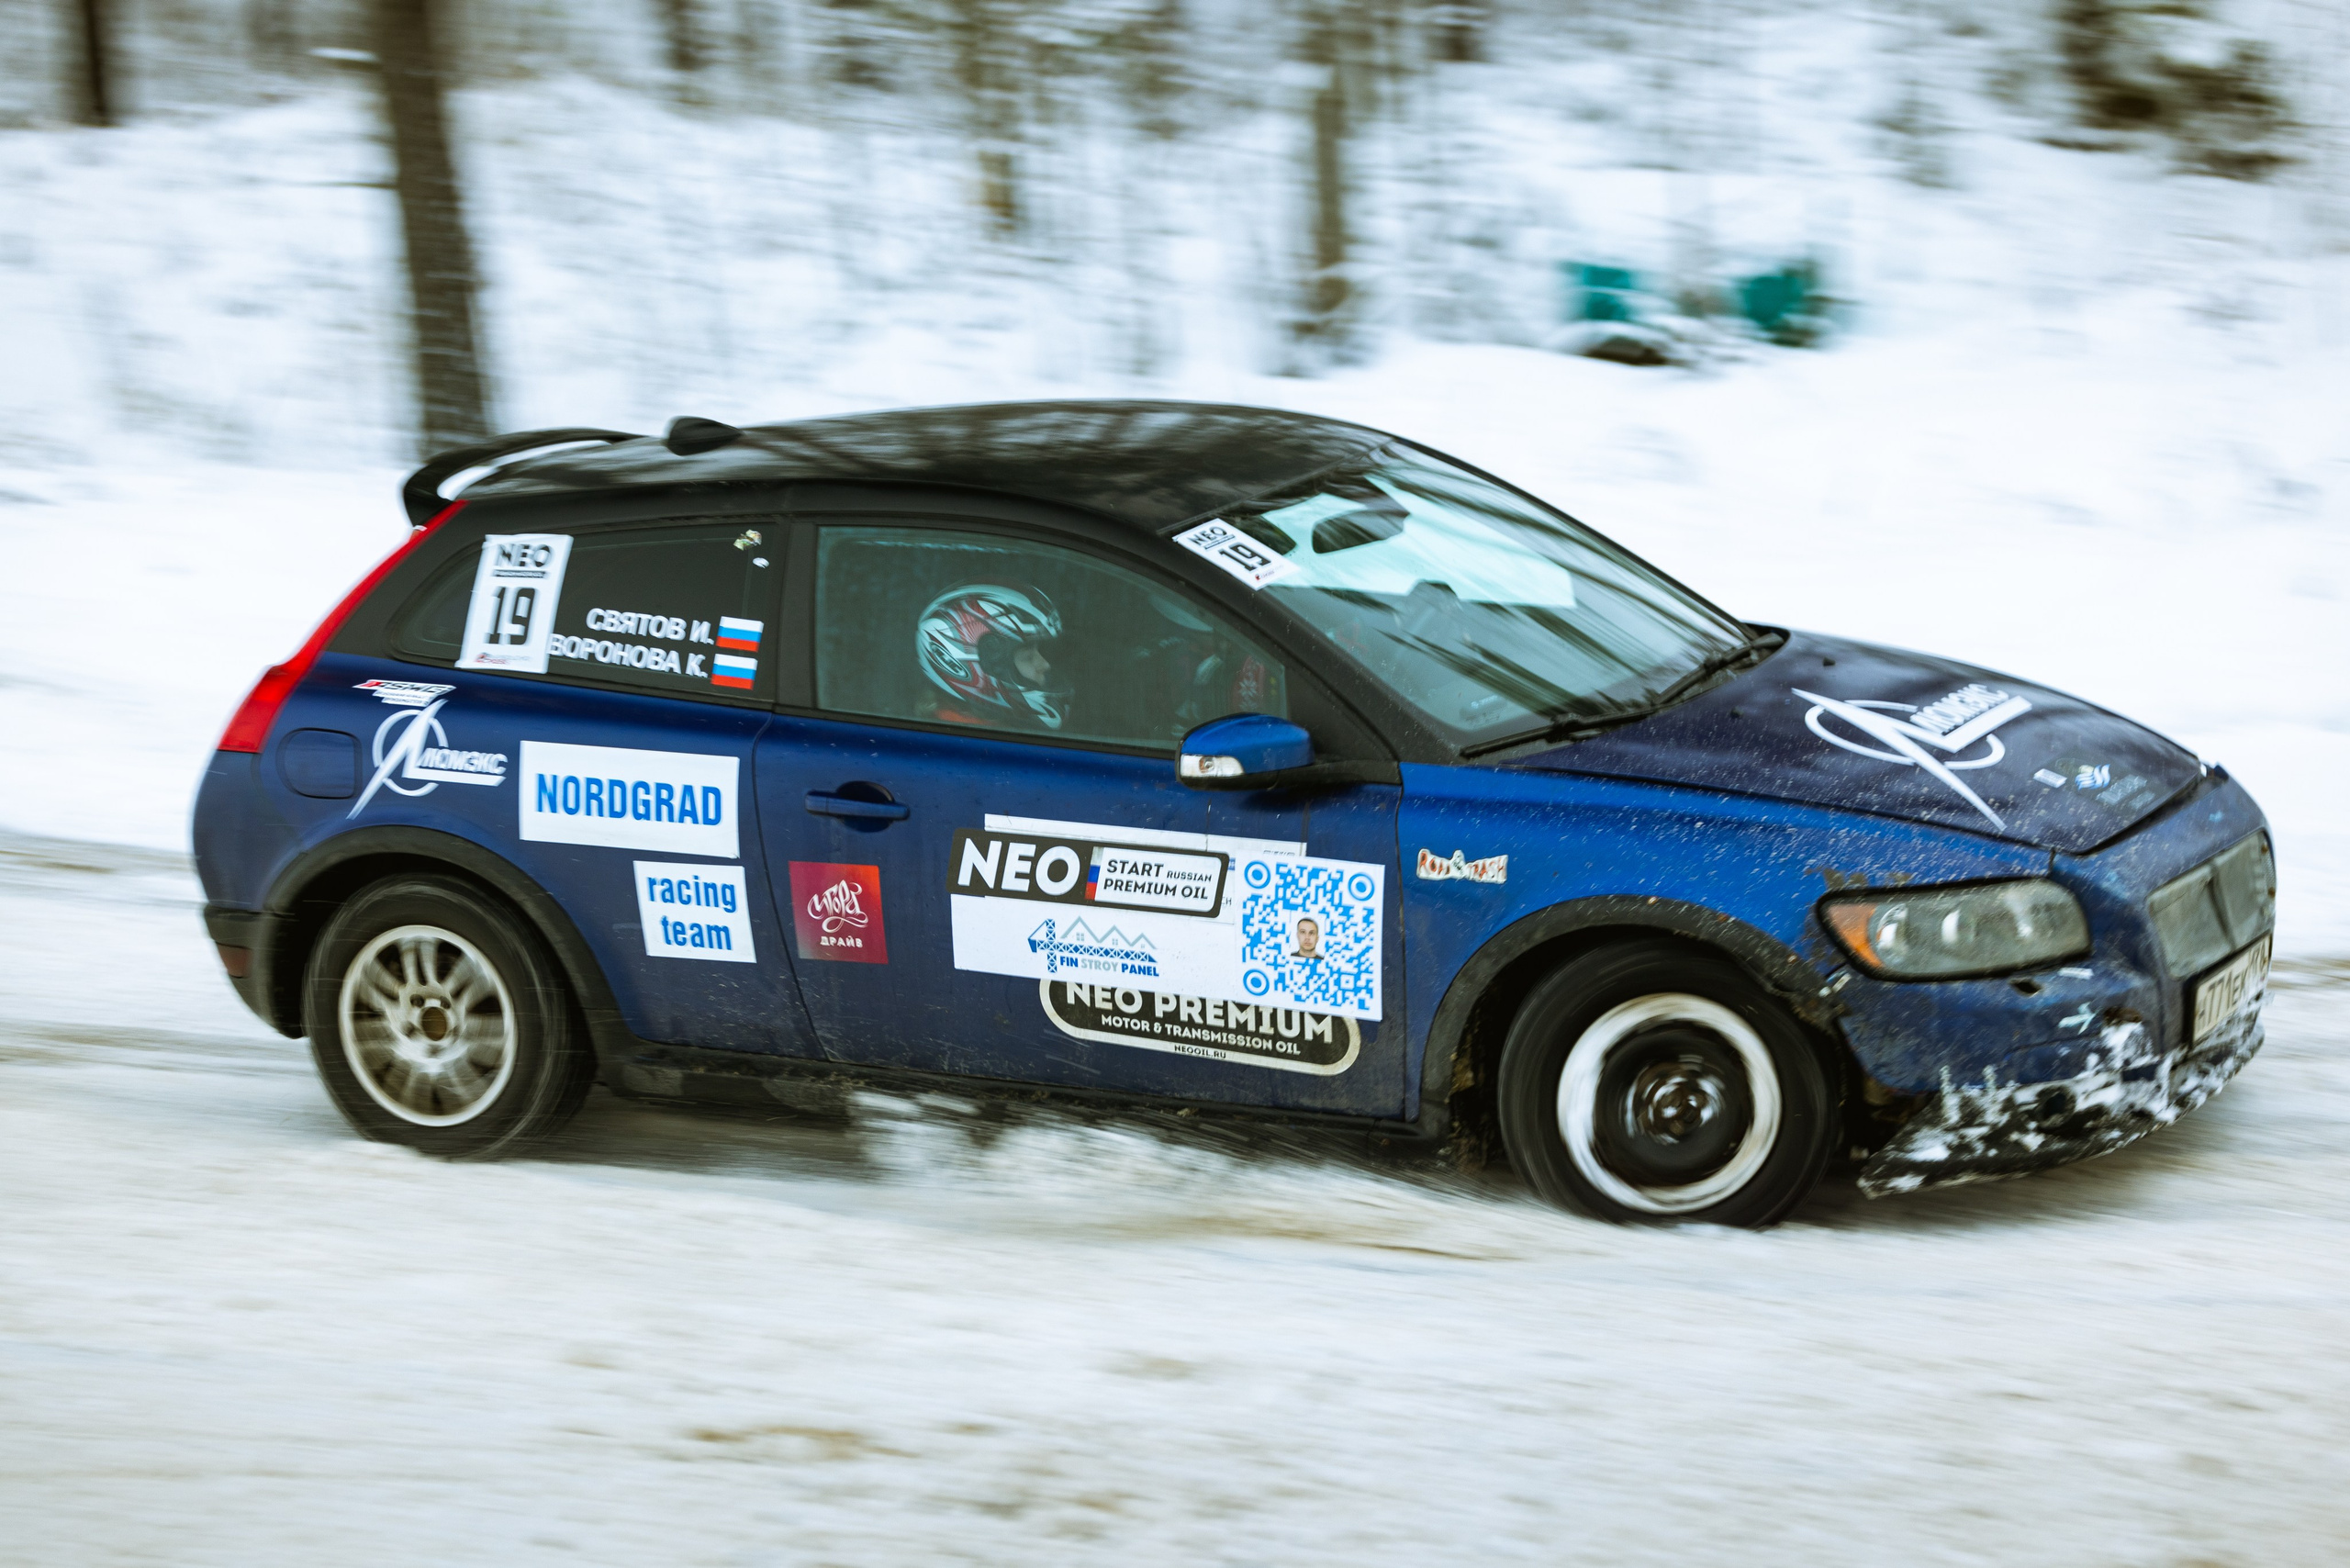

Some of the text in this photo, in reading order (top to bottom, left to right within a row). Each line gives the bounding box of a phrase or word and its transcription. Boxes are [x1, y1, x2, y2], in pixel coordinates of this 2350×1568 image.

[1187, 526, 1227, 546] NEO
[496, 543, 553, 567] NEO
[1218, 542, 1271, 572] 19
[485, 586, 540, 645] 19
[586, 608, 714, 644] СВЯТОВ И.
[549, 633, 709, 678] ВОРОНОВА К.
[535, 772, 722, 826] NORDGRAD
[957, 837, 1080, 896] NEO
[1106, 859, 1212, 883] START RUSSIAN
[646, 874, 738, 914] racing
[1103, 878, 1209, 900] PREMIUM OIL
[660, 914, 733, 951] team
[820, 935, 863, 948] ДРАЙВ
[1059, 955, 1160, 978] FIN STROY PANEL
[1066, 981, 1333, 1044] NEO PREMIUM
[1101, 1014, 1302, 1056] MOTOR & TRANSMISSION OIL
[1174, 1044, 1227, 1059] NEOOIL.RU
